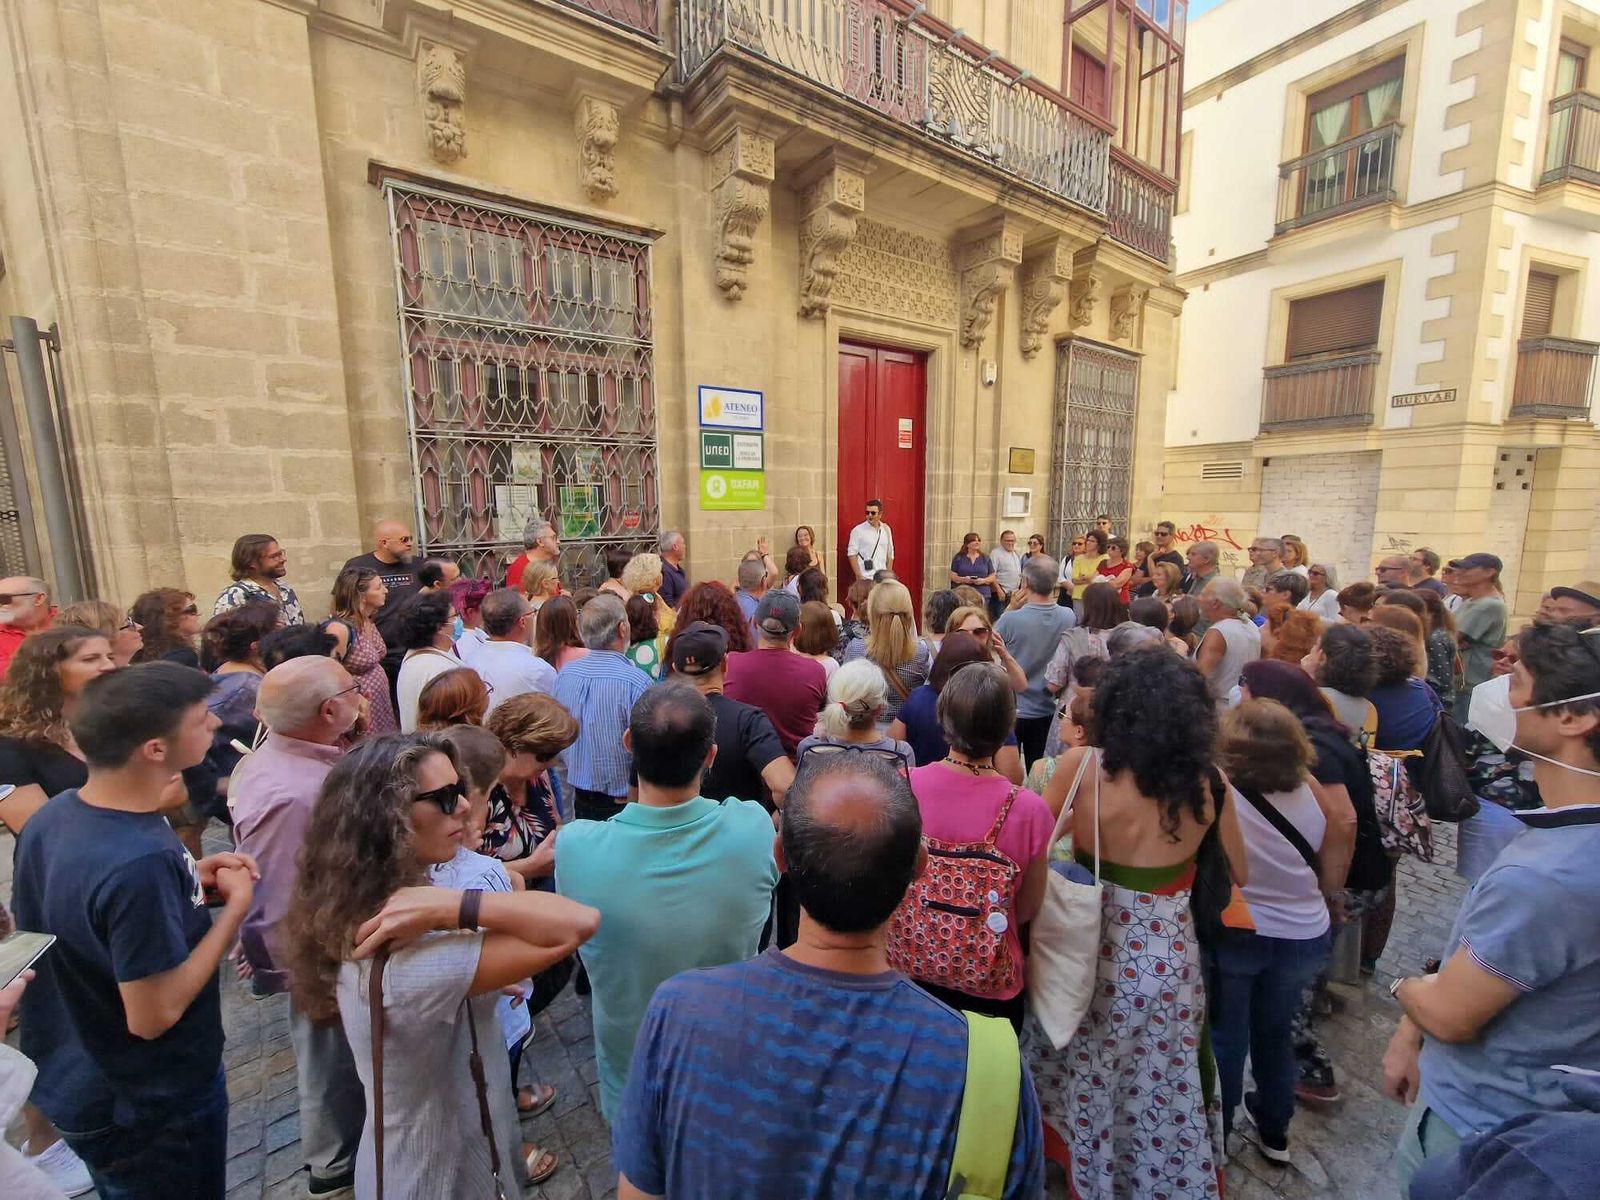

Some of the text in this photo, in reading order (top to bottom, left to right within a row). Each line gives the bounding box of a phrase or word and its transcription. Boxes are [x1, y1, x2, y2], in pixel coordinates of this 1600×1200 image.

[1395, 391, 1452, 405] HUEVAR
[724, 402, 758, 413] ATENEO
[705, 445, 729, 456] UNED
